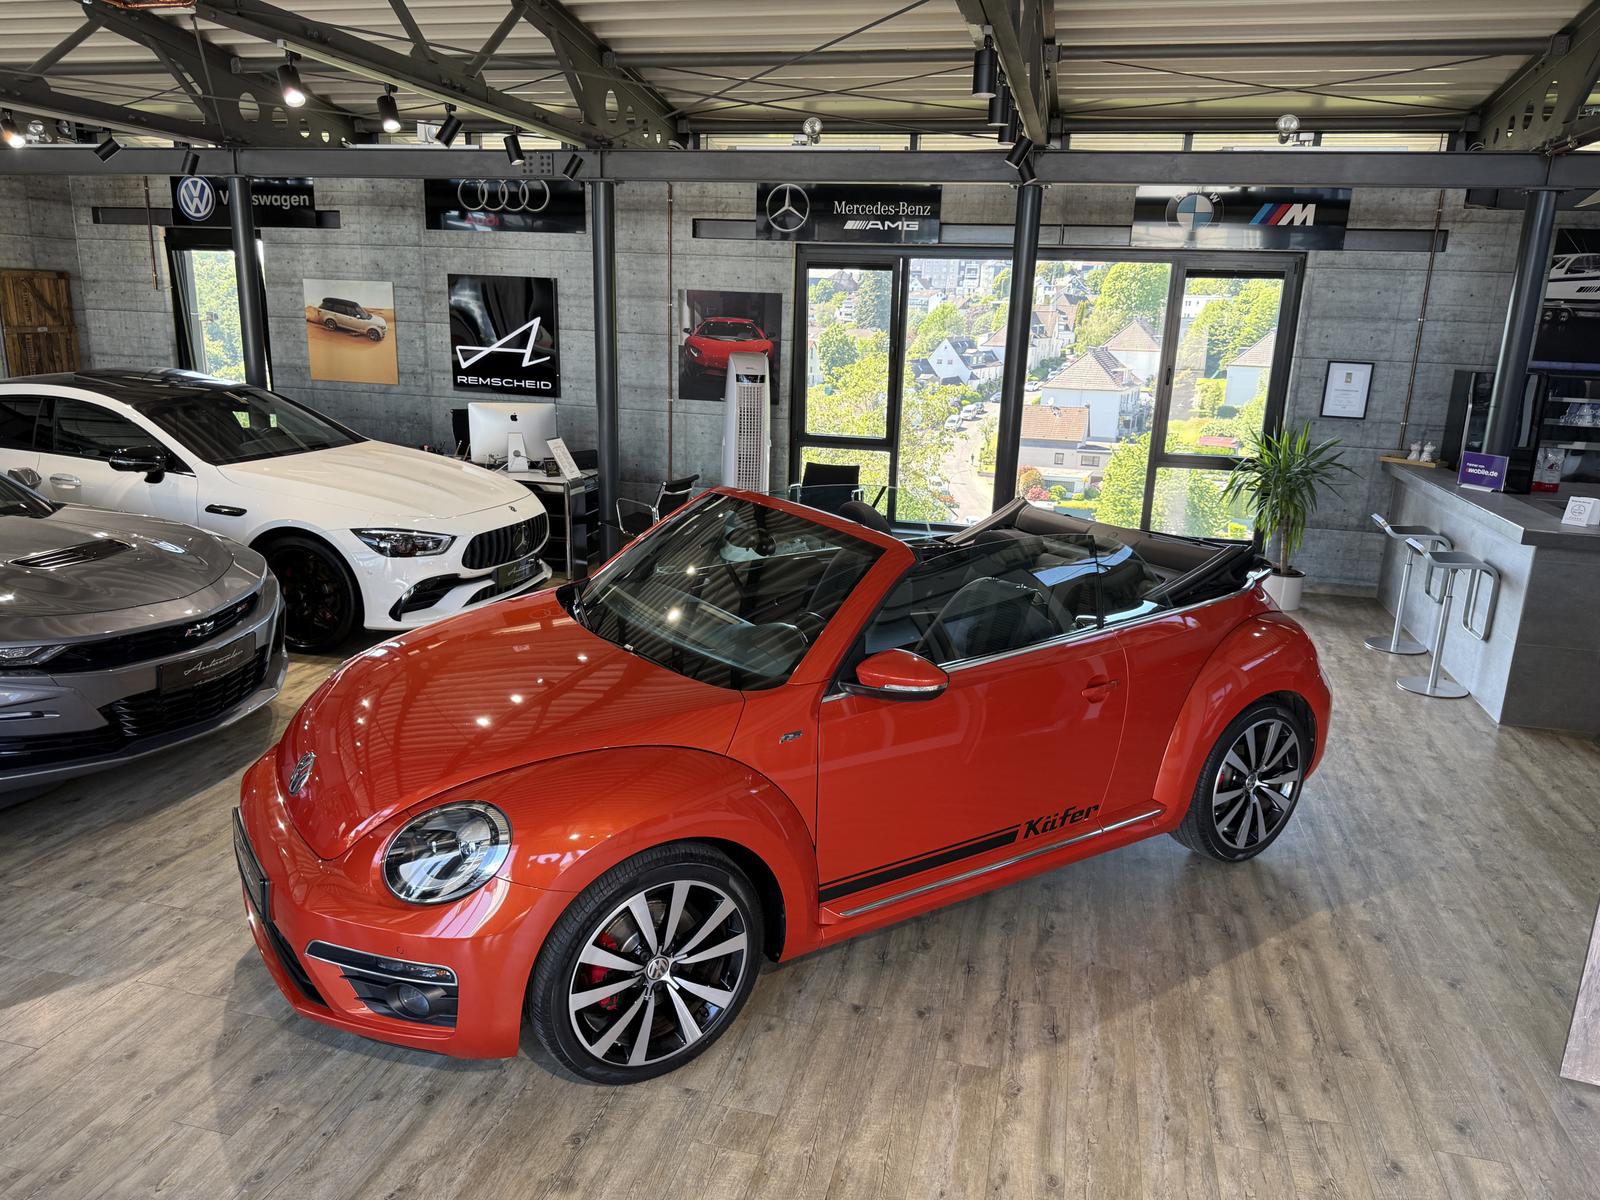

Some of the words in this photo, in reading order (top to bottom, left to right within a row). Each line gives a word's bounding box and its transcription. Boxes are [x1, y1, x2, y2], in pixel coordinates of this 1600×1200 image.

[218, 190, 310, 210] Vswagen
[833, 200, 931, 216] Mercedes-Benz
[865, 220, 920, 231] AMG
[456, 375, 552, 390] REMSCHEID
[1467, 467, 1499, 478] mobile.de
[1023, 804, 1100, 839] Käfer
